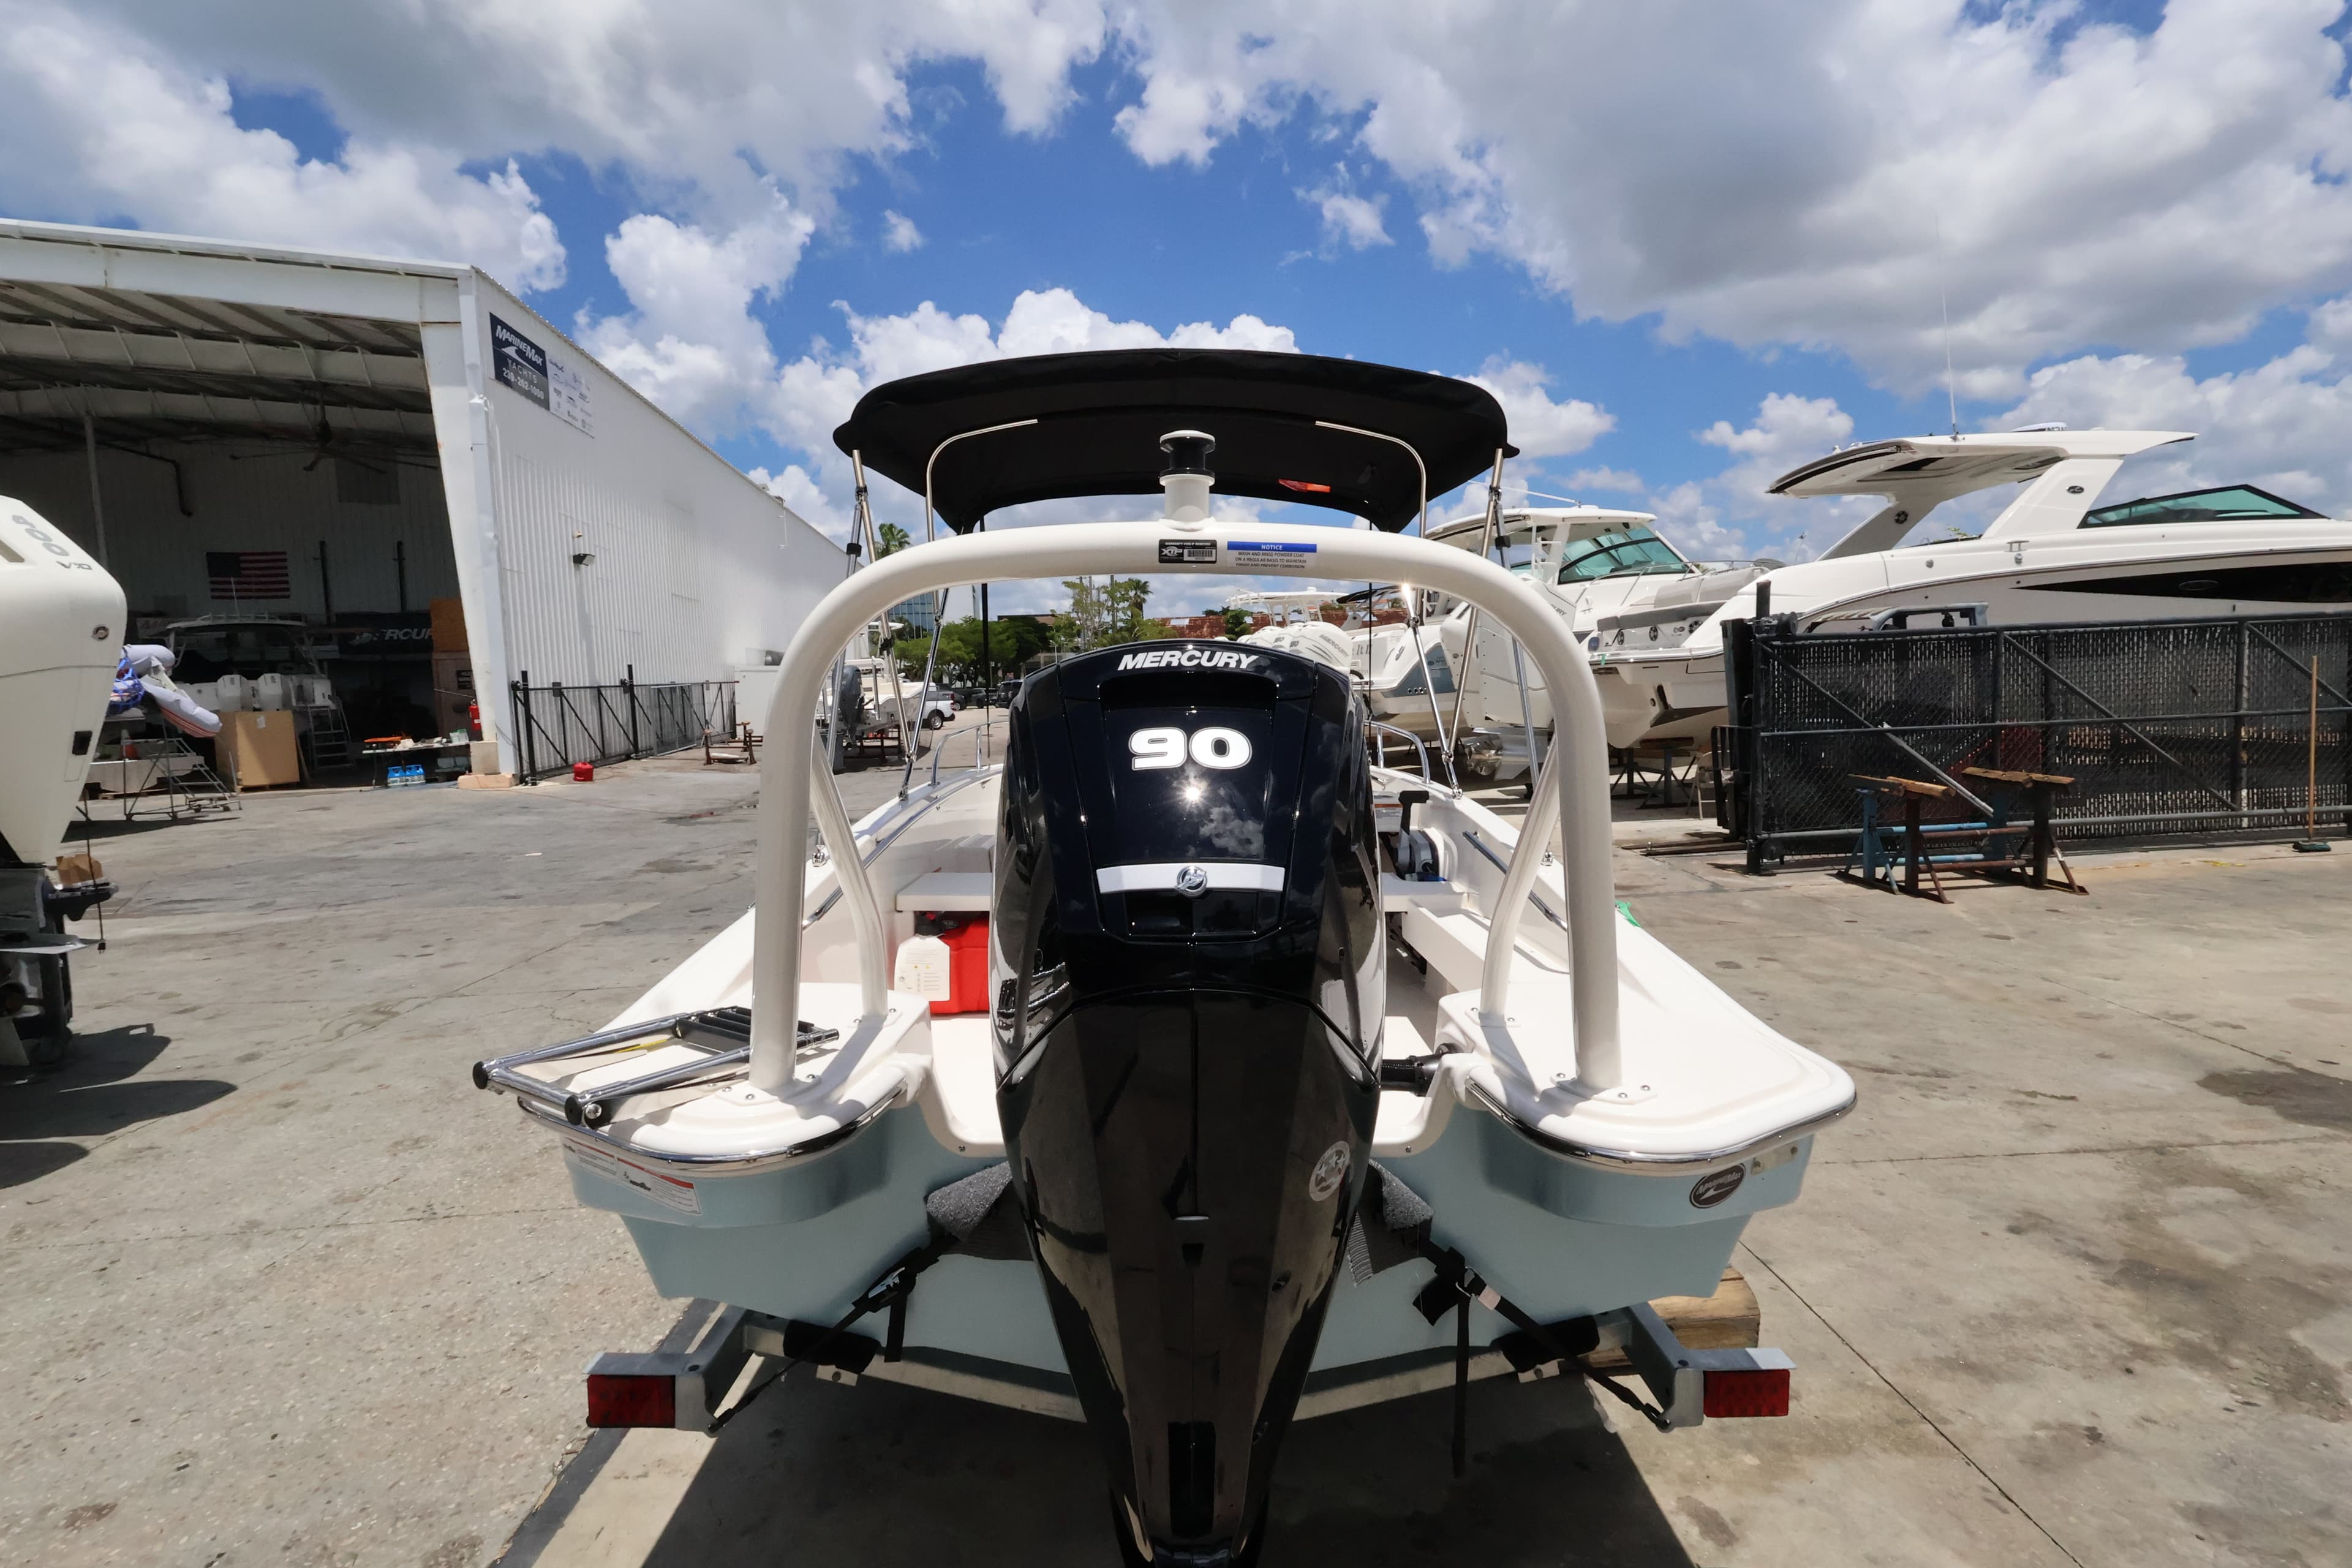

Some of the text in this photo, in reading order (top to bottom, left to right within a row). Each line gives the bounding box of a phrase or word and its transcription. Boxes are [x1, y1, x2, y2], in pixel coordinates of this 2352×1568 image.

[507, 358, 537, 383] YACHTS
[12, 514, 69, 557] 400
[1117, 650, 1259, 671] MERCURY
[1128, 726, 1253, 771] 90
